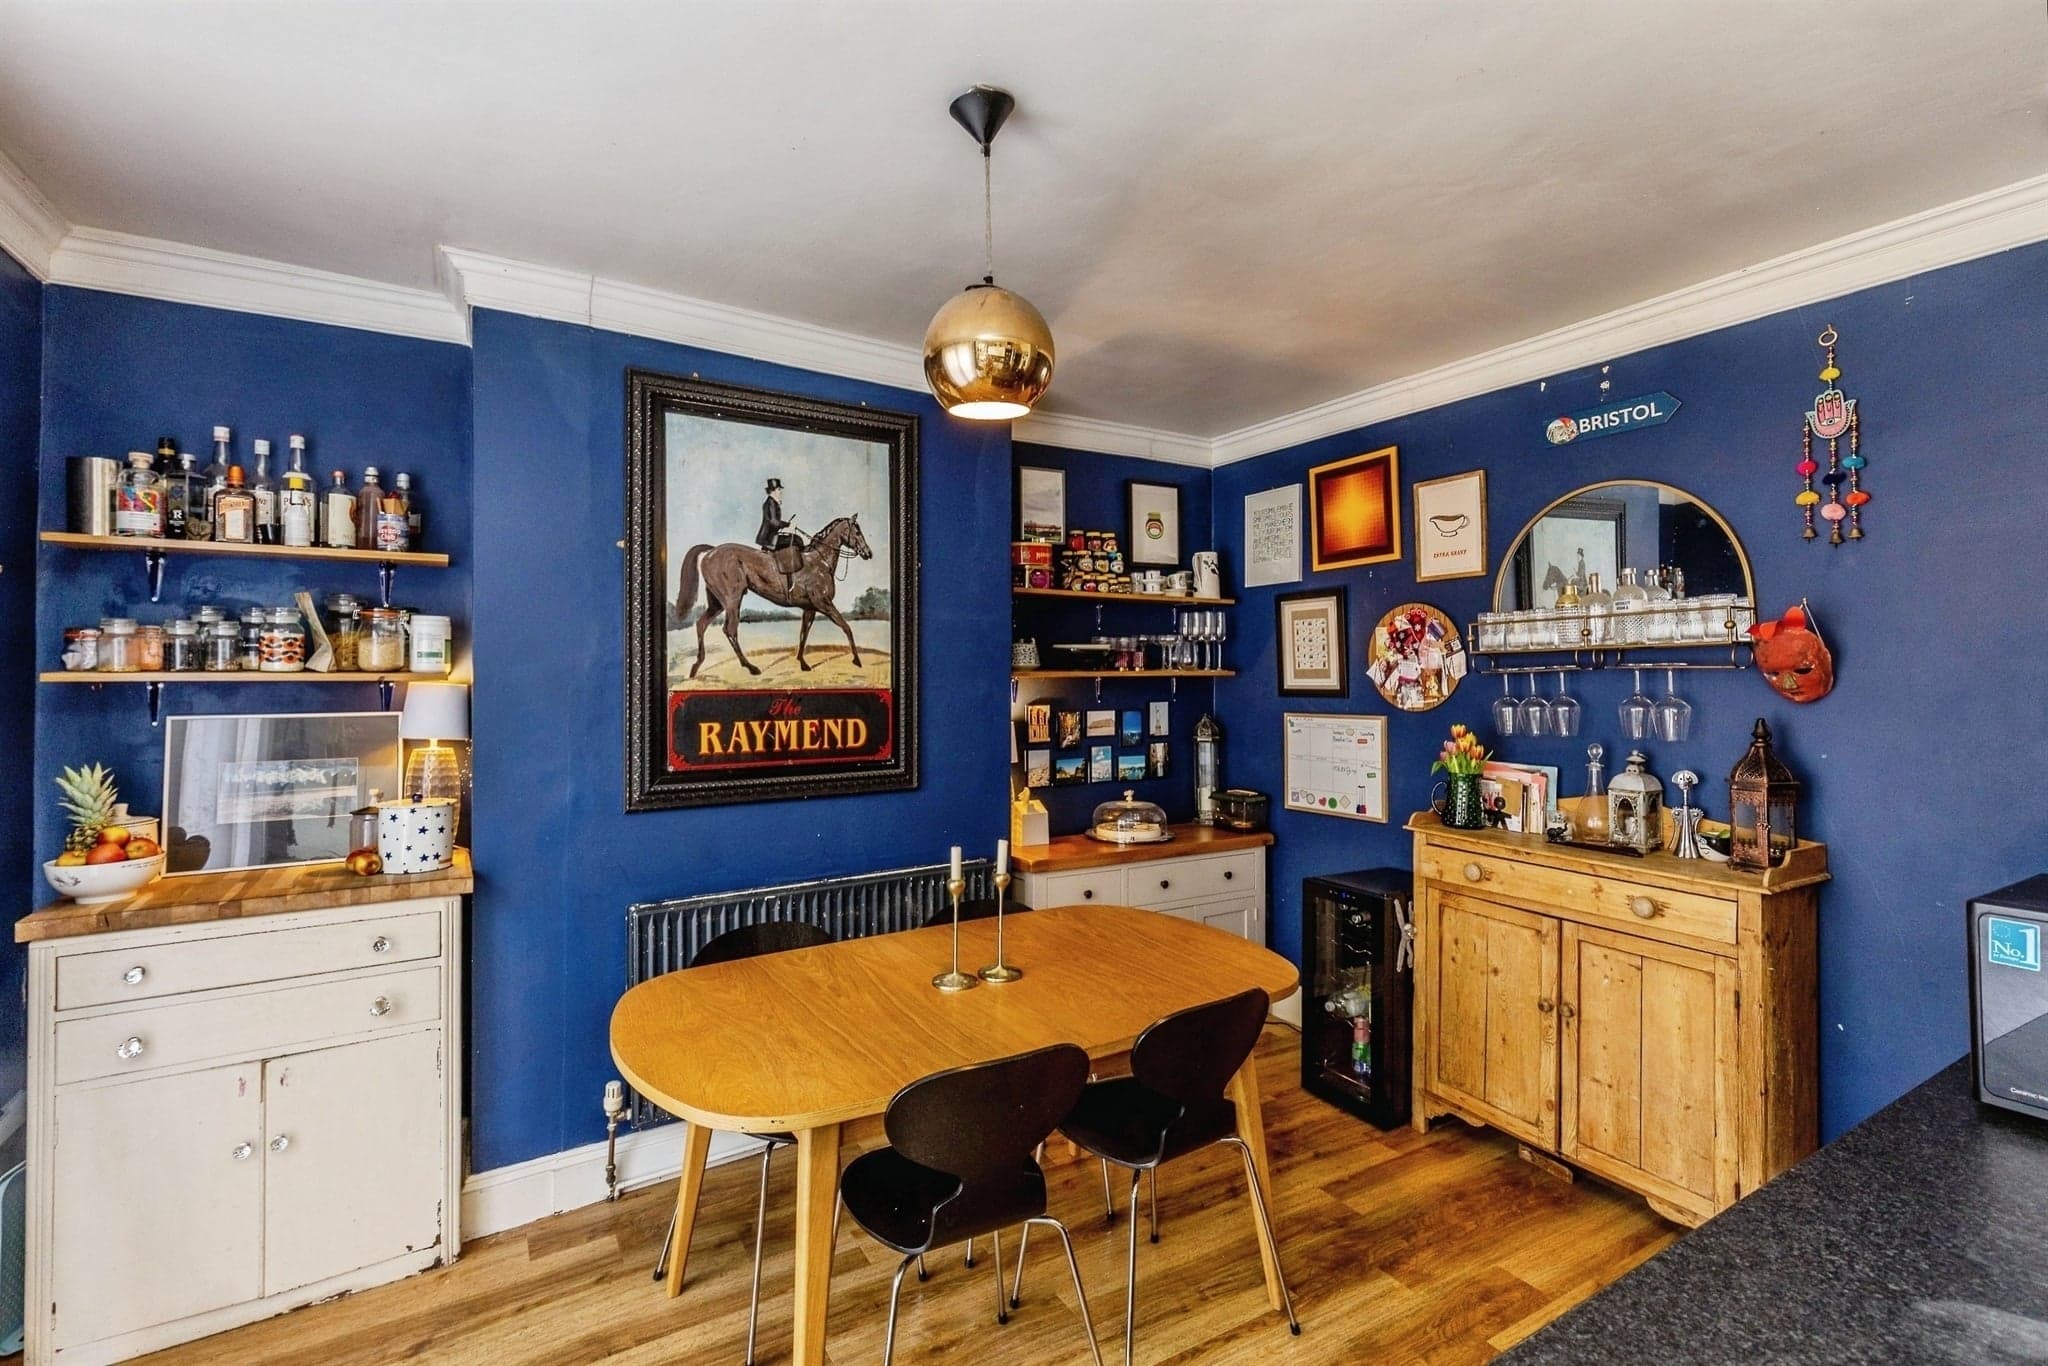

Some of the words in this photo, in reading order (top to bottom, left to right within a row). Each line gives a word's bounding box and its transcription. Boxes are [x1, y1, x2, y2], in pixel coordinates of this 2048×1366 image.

[1579, 402, 1663, 434] BRISTOL
[768, 697, 803, 716] The
[698, 718, 868, 757] RAYMEND
